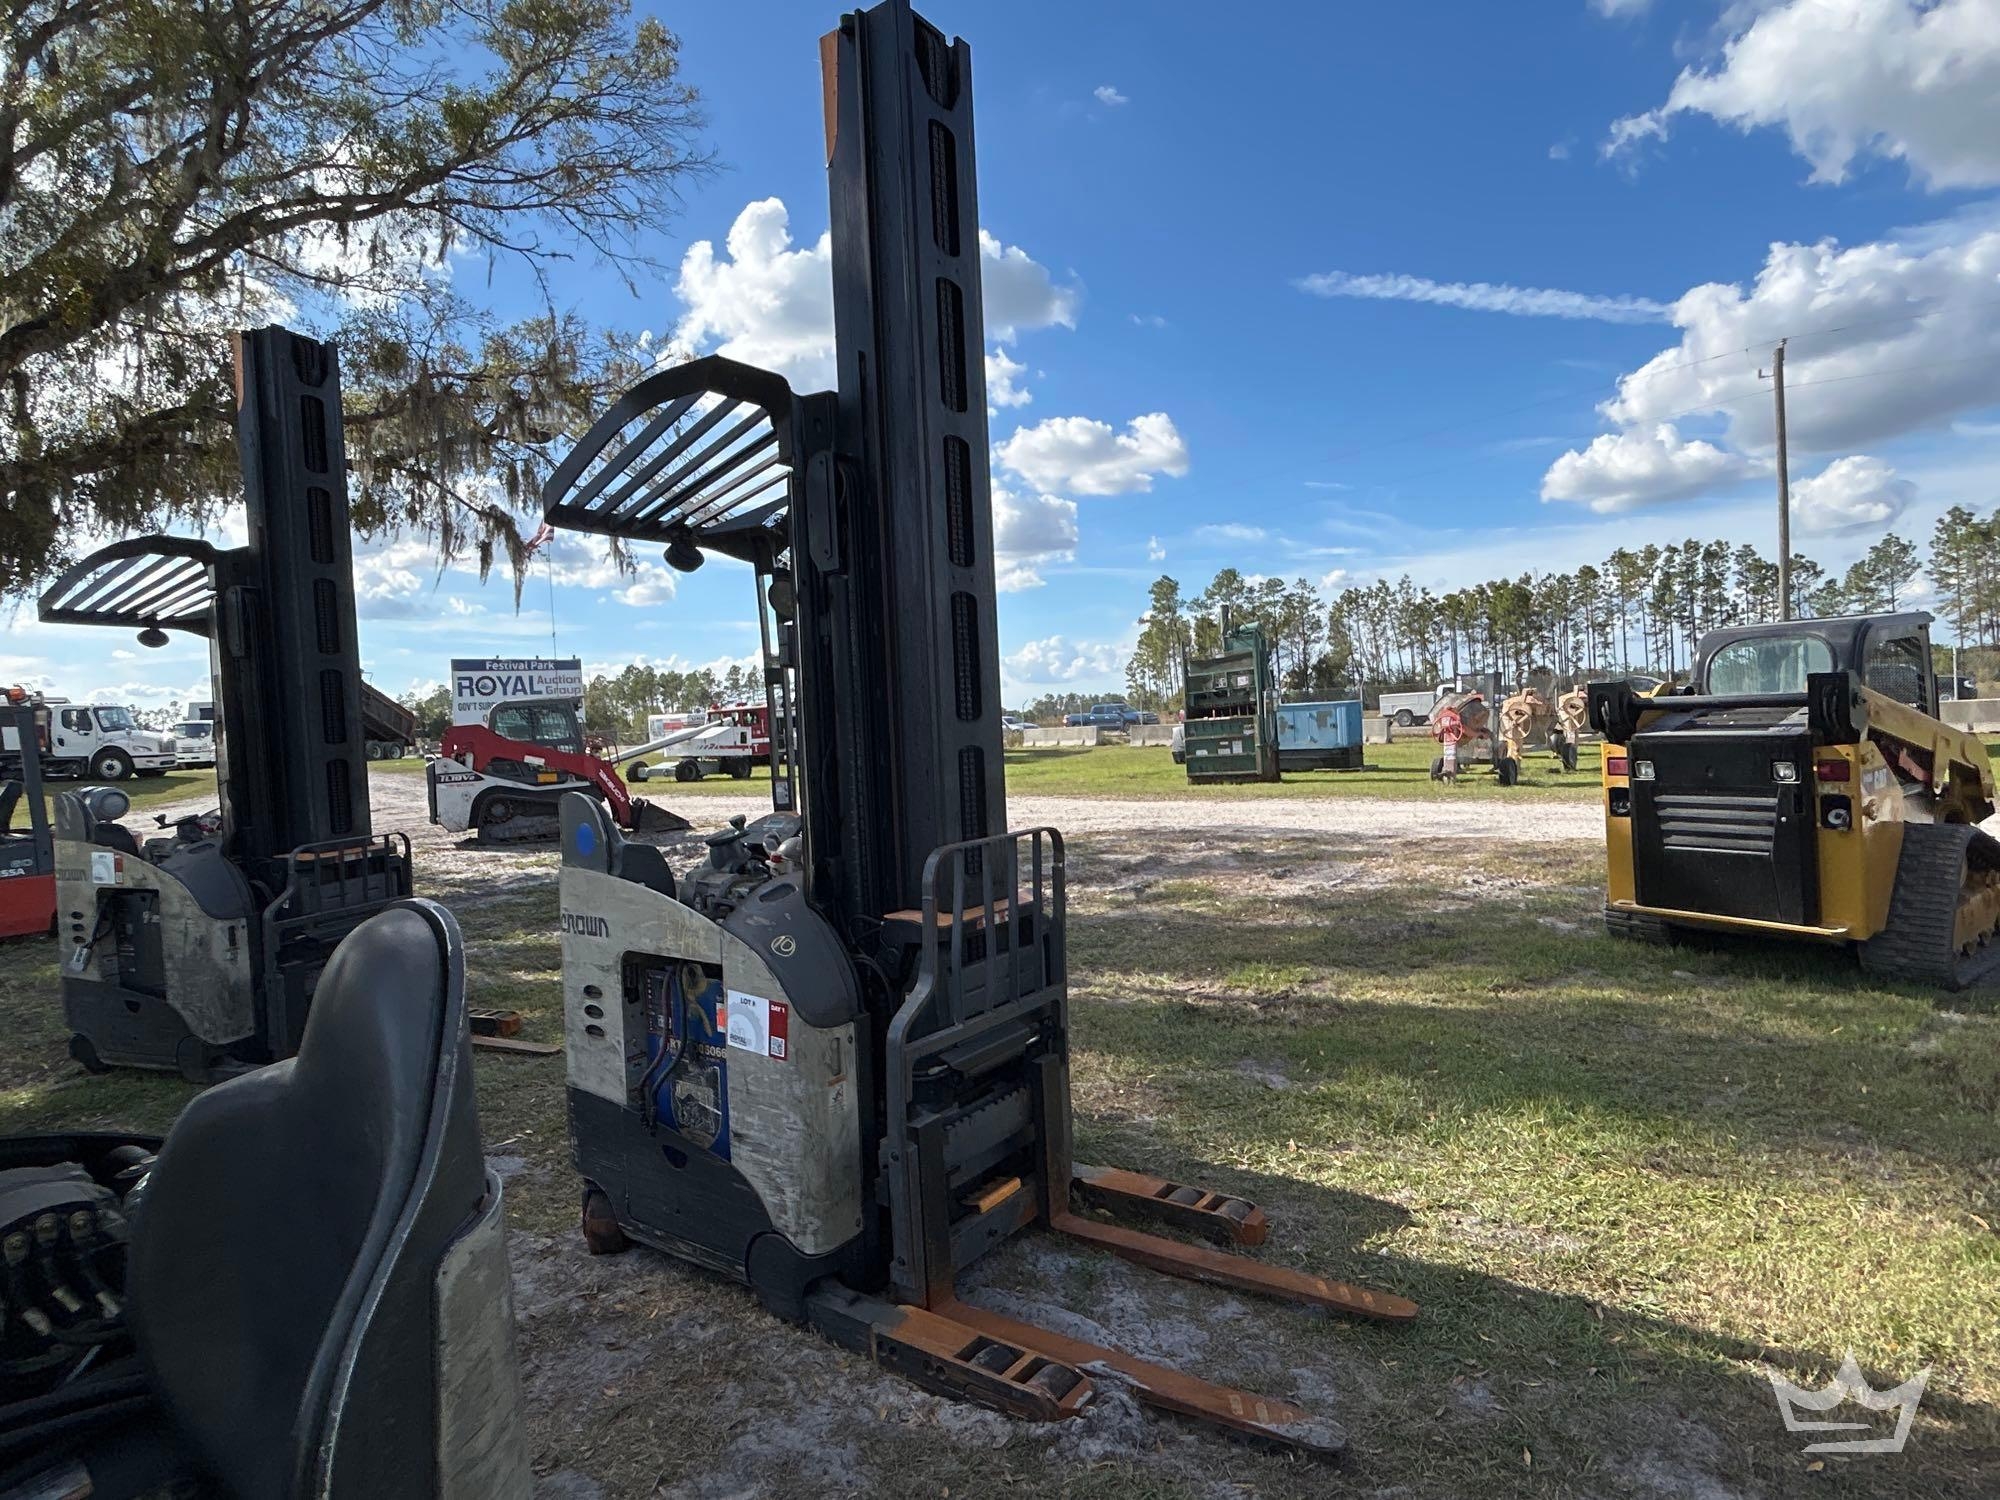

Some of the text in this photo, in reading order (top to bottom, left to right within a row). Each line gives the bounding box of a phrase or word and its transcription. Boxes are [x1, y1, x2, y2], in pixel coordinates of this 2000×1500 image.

[485, 660, 555, 670] Festival Park
[457, 674, 581, 697] ROYAL Auction
[545, 685, 582, 695] Group
[458, 703, 477, 711] GOV'T
[740, 997, 751, 1006] LOT
